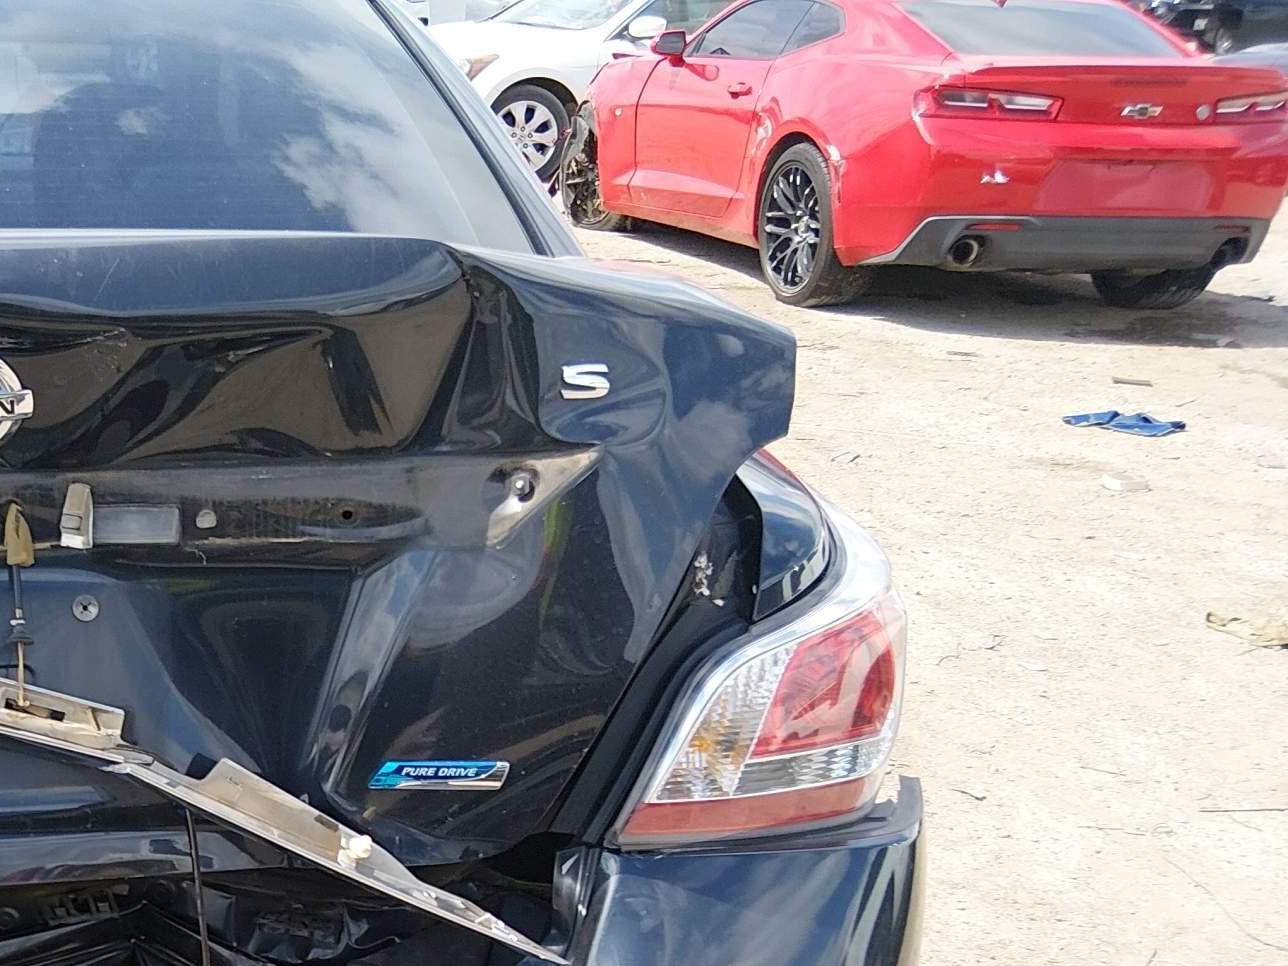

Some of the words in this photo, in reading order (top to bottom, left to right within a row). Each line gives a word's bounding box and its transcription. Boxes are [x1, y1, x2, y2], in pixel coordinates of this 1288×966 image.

[560, 362, 610, 399] S
[401, 767, 436, 776] PURE
[438, 767, 478, 777] DRIVE
